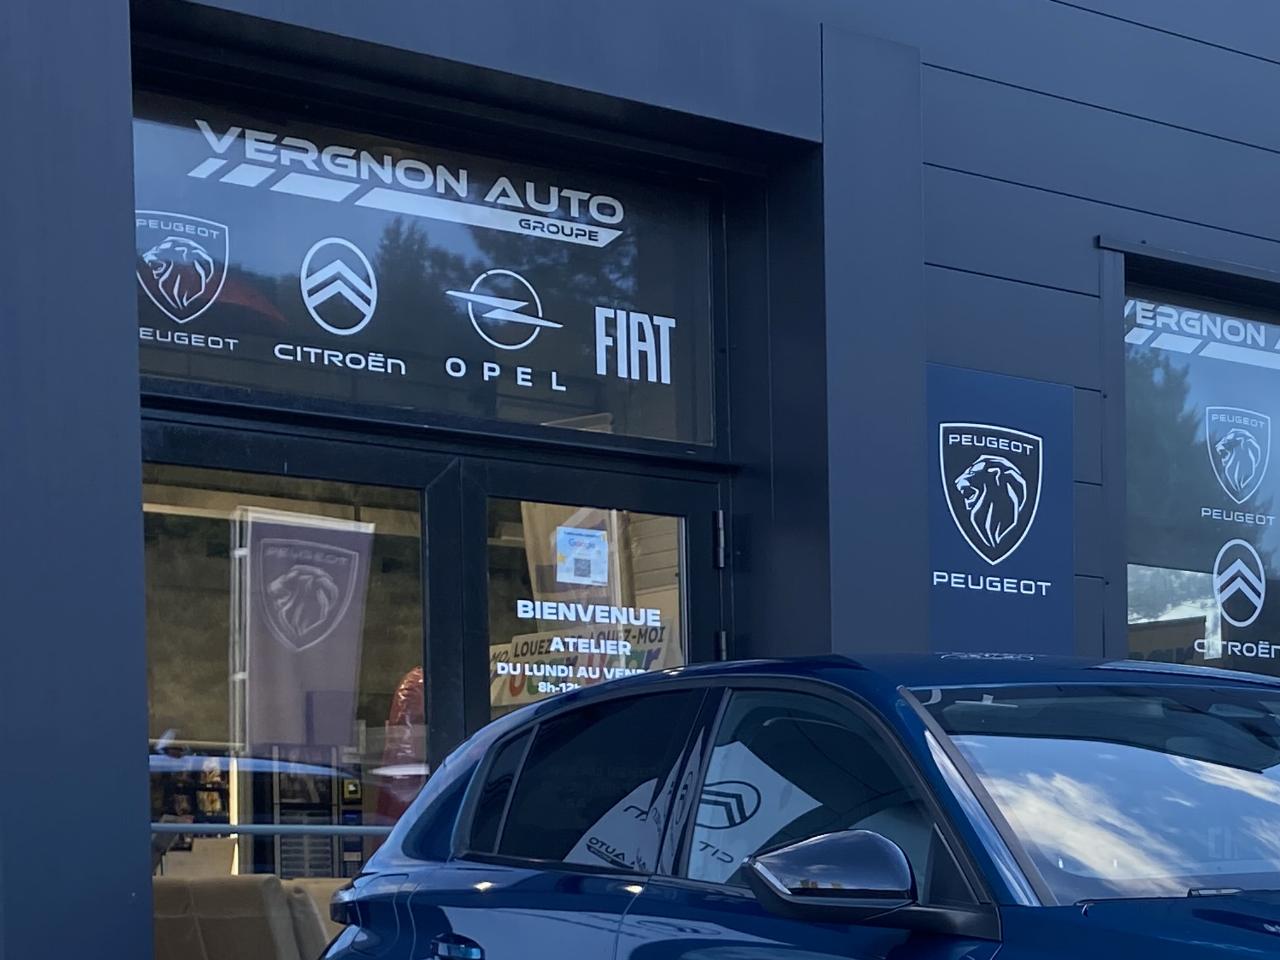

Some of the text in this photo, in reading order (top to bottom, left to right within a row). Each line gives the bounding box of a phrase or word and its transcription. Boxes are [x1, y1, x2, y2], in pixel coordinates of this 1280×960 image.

[195, 119, 625, 225] VERGNON AUTO
[519, 218, 599, 242] GROUPE
[595, 306, 676, 385] FIAT
[445, 357, 567, 391] OPEL
[1211, 414, 1265, 428] PEUGEOT
[949, 434, 1034, 455] PEUGEOT
[1201, 507, 1276, 526] PEUGEOT
[933, 571, 1052, 596] PEUGEOT
[516, 600, 661, 627] BIENVENUE
[549, 637, 632, 656] ATELIER
[496, 661, 521, 675] DU
[527, 664, 573, 677] LUNDI
[576, 666, 600, 679] AU
